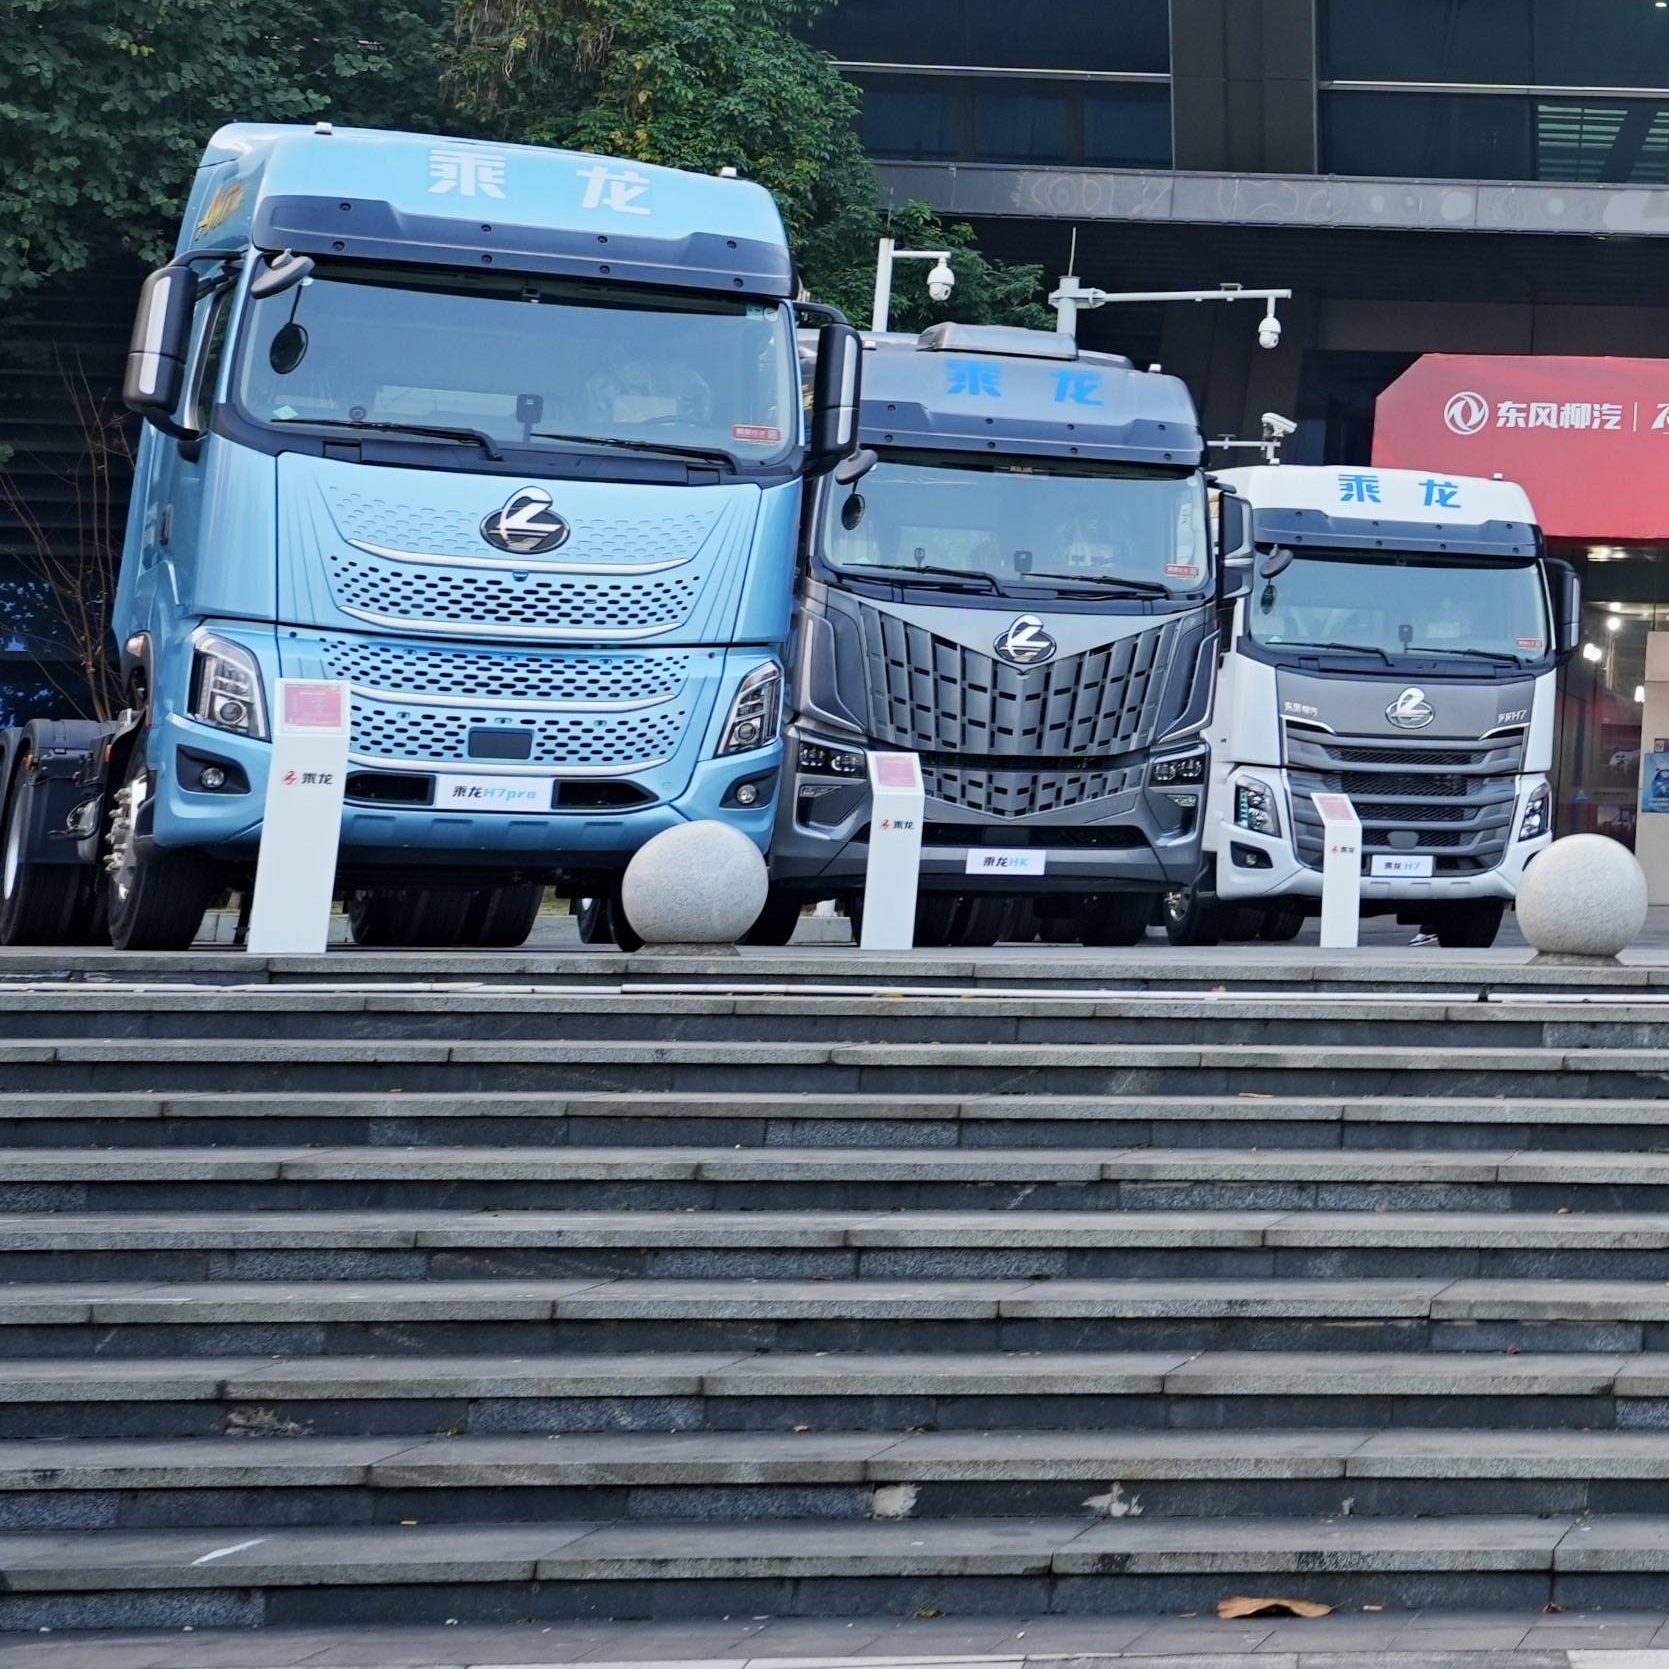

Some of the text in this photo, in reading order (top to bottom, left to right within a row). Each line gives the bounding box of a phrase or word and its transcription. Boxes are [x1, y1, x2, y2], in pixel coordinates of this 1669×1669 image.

[428, 150, 651, 215] 乘龙
[945, 359, 1104, 406] 乘龙
[1496, 400, 1623, 430] 东风柳汽
[1338, 474, 1462, 509] 乘龙
